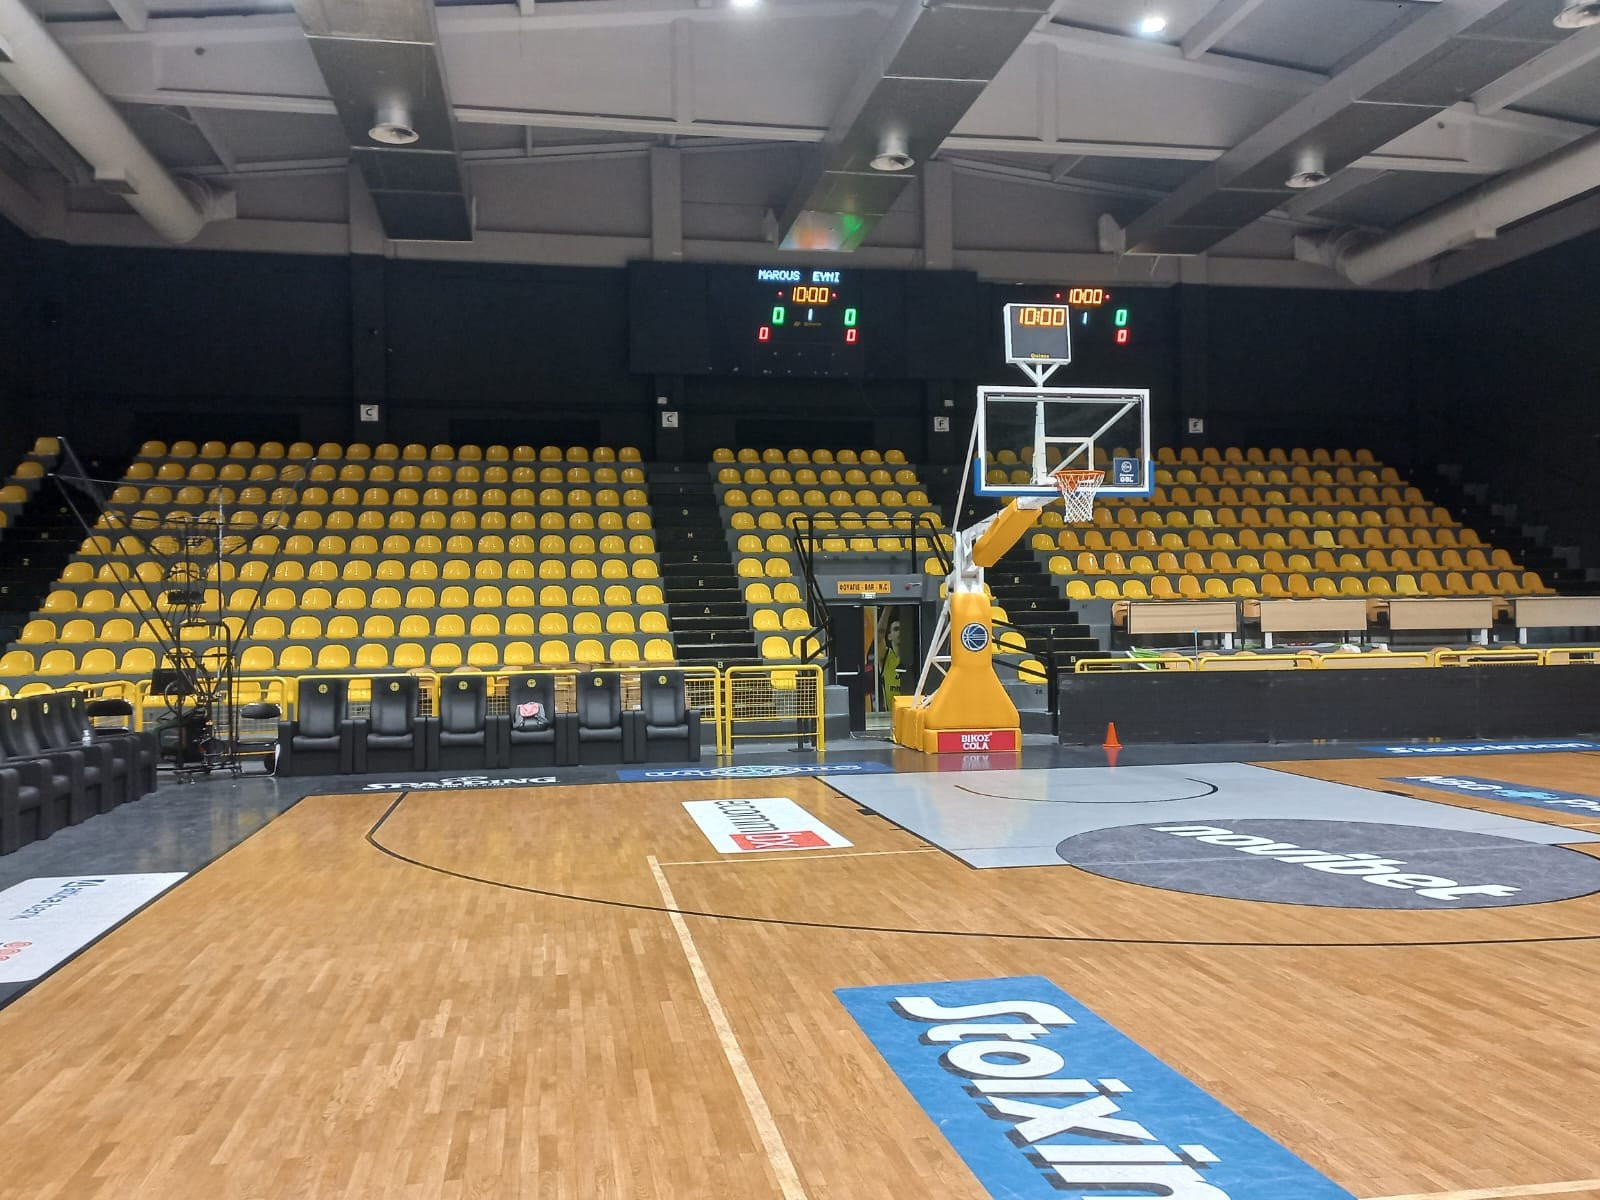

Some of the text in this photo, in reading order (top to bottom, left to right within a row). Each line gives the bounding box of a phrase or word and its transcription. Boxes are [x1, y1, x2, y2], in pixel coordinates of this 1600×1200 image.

[758, 269, 801, 281] MAROUS
[792, 286, 829, 303] 10:00
[1068, 288, 1103, 305] 10:00
[772, 306, 785, 325] 0
[807, 308, 813, 321] 1
[844, 308, 857, 327] 0
[1019, 307, 1065, 326] 10:00
[1082, 311, 1088, 325] 1
[1115, 309, 1128, 327] 0
[758, 326, 769, 340] 0
[846, 328, 857, 342] 0
[1117, 329, 1128, 343] 0
[963, 742, 990, 750] COLA
[362, 776, 560, 791] SPALDING
[1150, 825, 1522, 901] novibet
